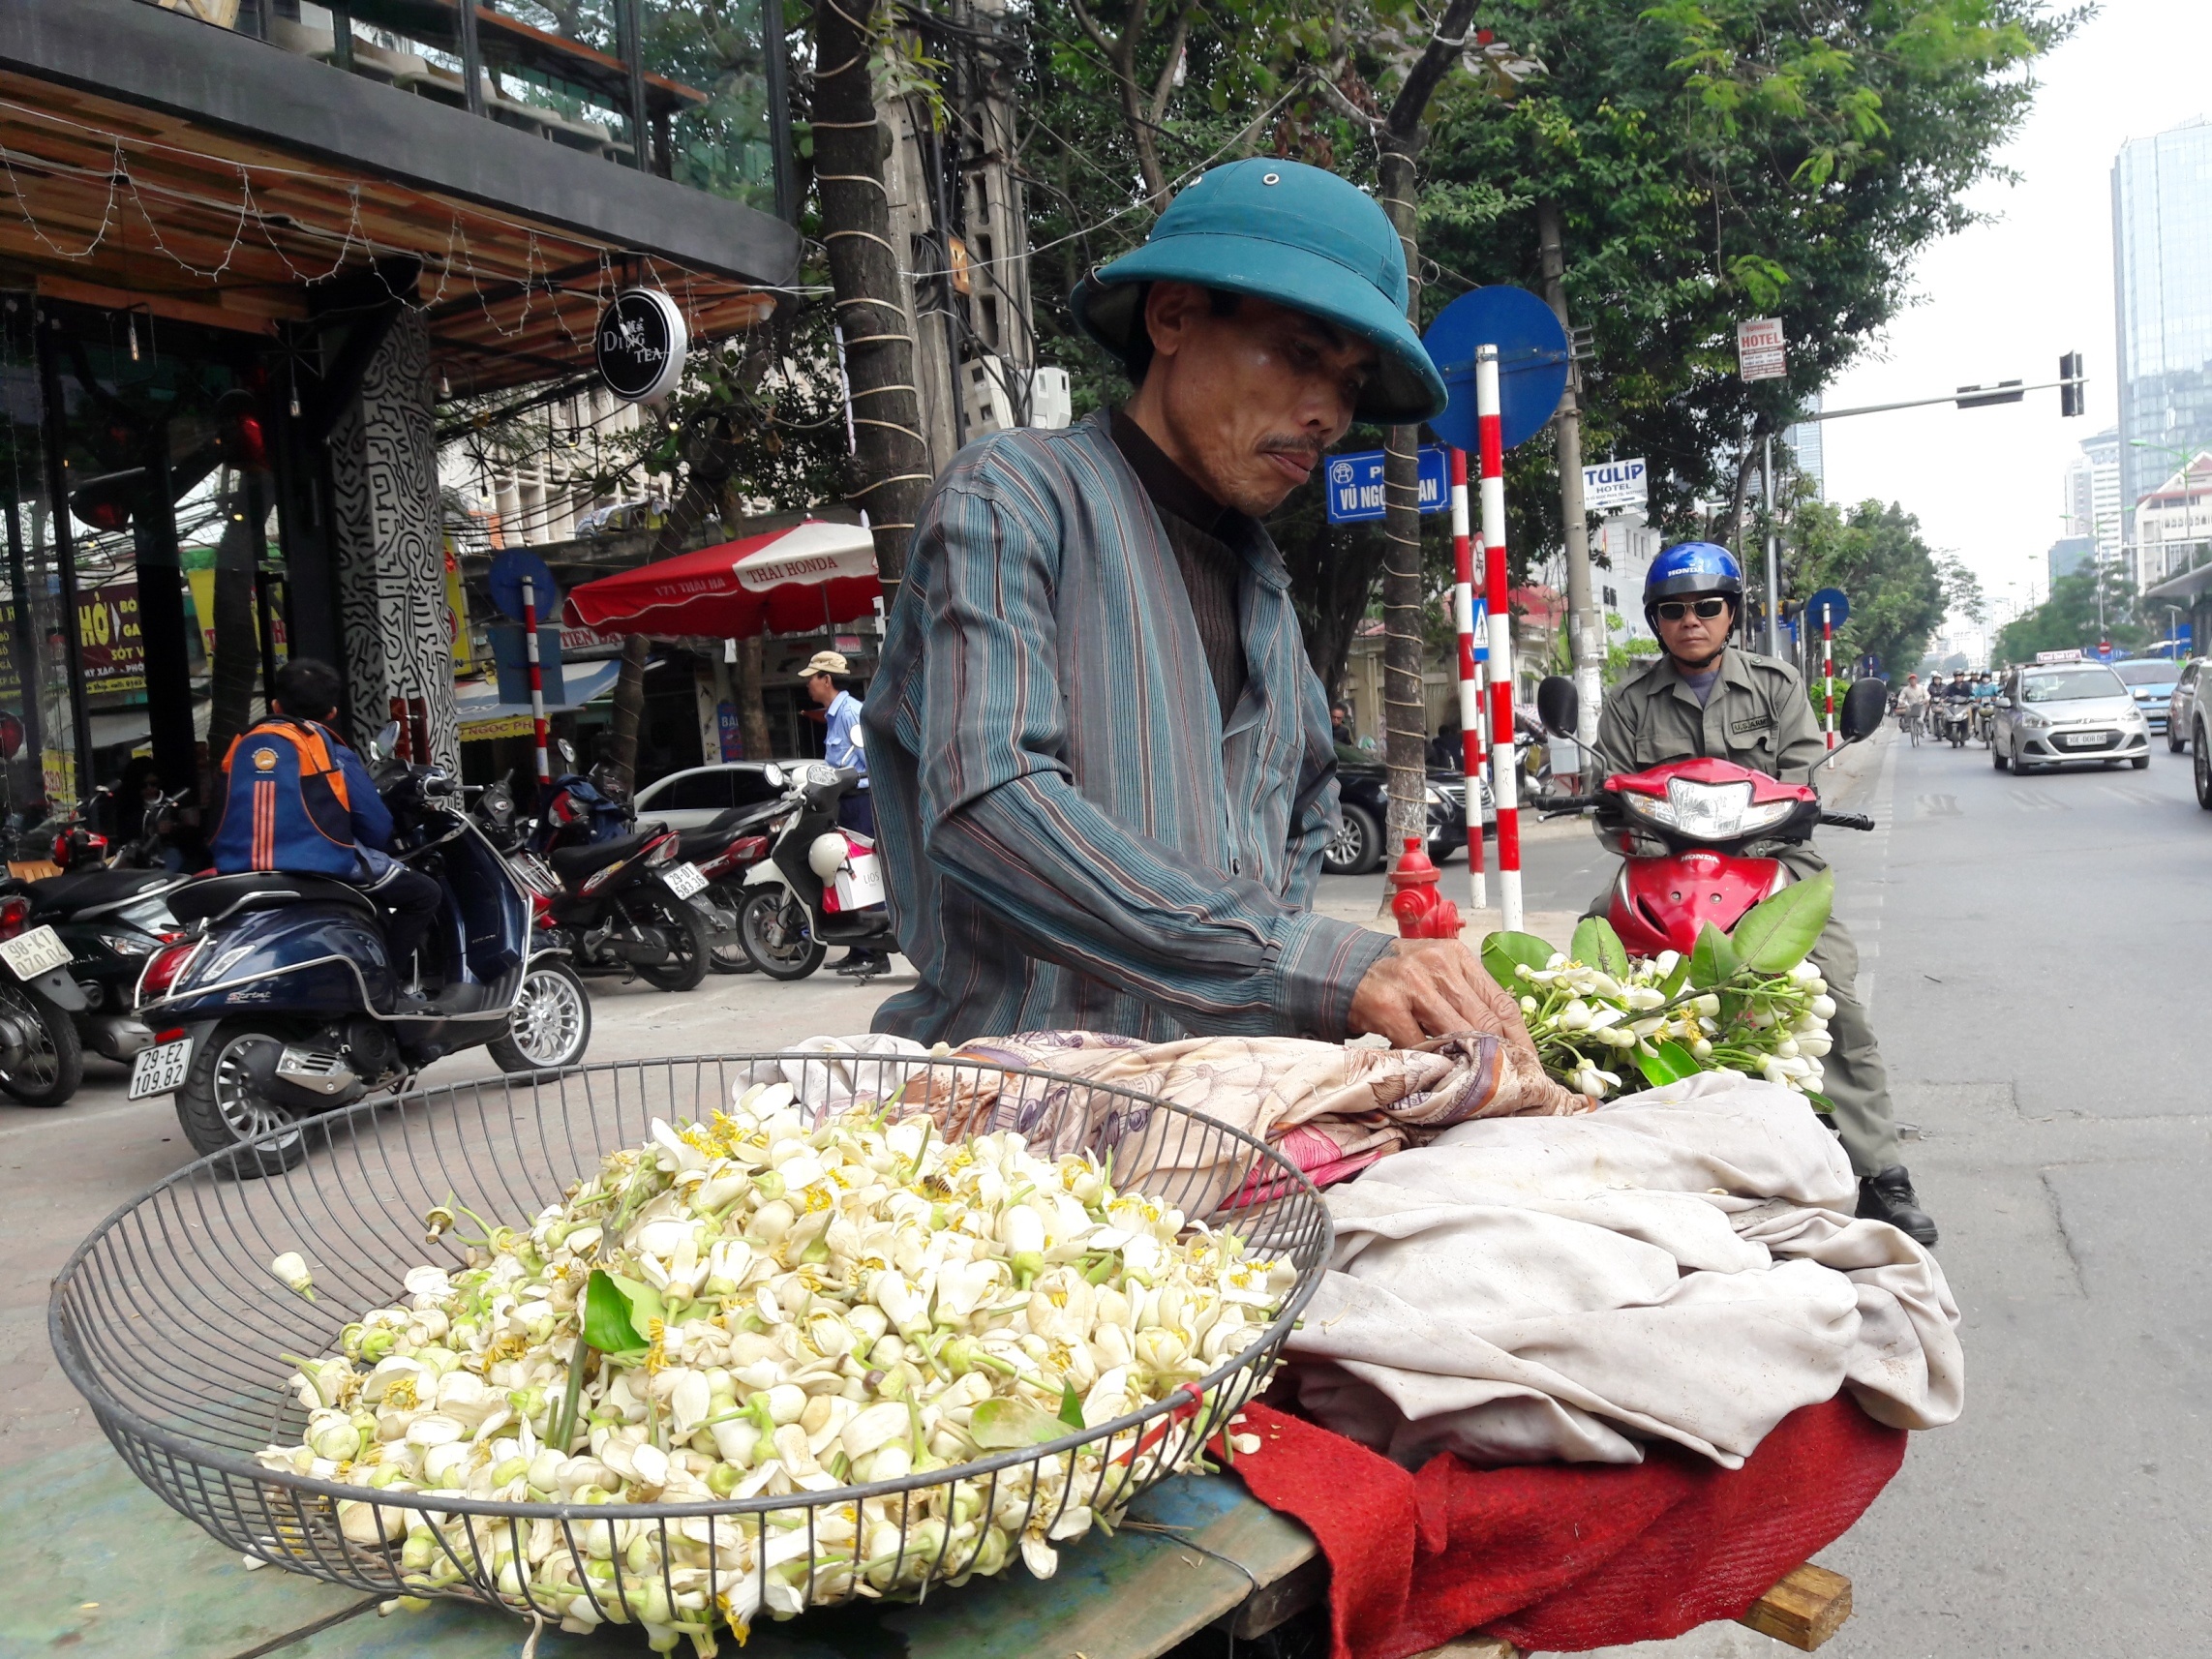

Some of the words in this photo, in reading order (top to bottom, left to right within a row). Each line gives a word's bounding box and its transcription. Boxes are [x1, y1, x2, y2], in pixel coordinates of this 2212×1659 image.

[1742, 332, 1780, 347] HOTEL
[634, 347, 662, 363] TEA
[1340, 484, 1357, 510] VŨ
[1360, 484, 1385, 510] NGỌ
[1596, 484, 1631, 493] HOTEL
[746, 562, 781, 583] THÁI
[783, 556, 838, 576] HONDA
[1667, 566, 1704, 577] HONDA
[78, 591, 109, 647] HỞ
[1681, 854, 1720, 864] HONDA
[675, 875, 706, 896] 583.36
[7, 931, 51, 959] 98-K1
[141, 1042, 183, 1072] 29-E2
[136, 1065, 183, 1096] 109.82
